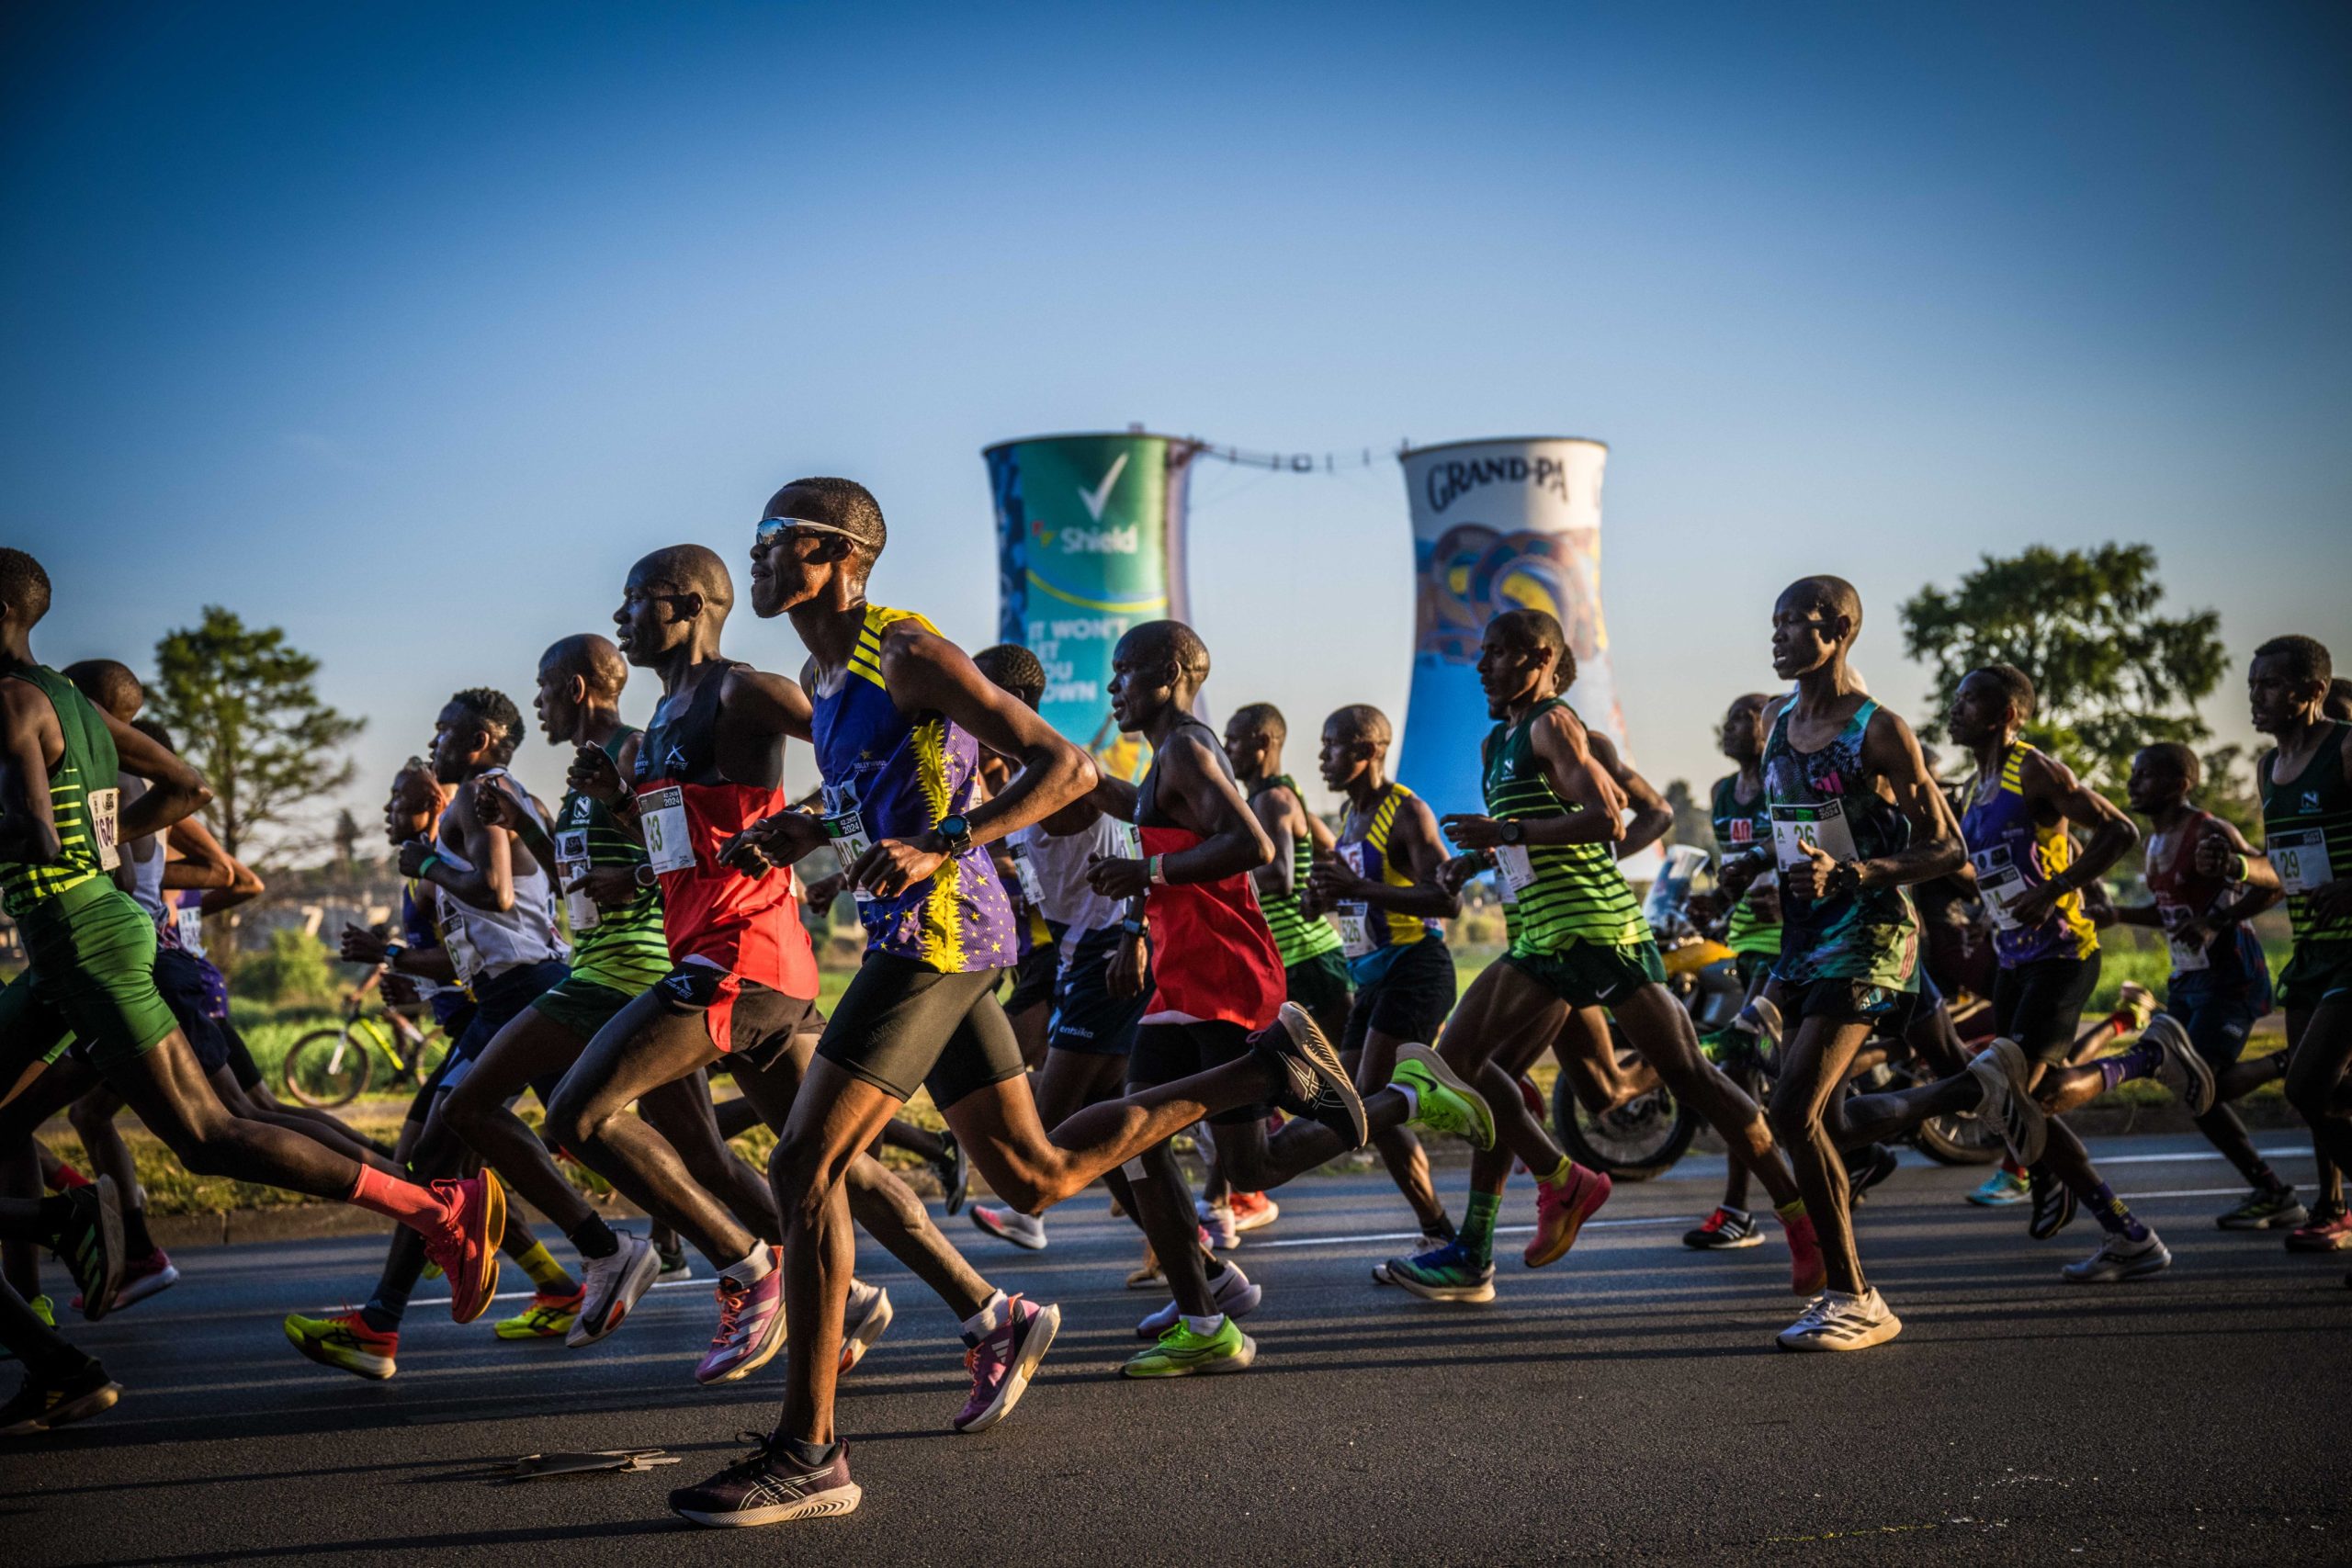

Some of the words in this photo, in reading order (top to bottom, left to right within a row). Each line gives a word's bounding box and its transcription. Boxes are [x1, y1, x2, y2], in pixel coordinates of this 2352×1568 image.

[1426, 456, 1568, 513] GRAND-PA
[1059, 525, 1138, 554] Shield
[1028, 621, 1046, 641] IT
[1041, 660, 1074, 681] OU
[1040, 681, 1099, 704] OWN
[663, 797, 681, 807] 2024
[1819, 807, 1839, 819] 2024
[842, 822, 860, 835] 2024
[2279, 850, 2301, 879] 29
